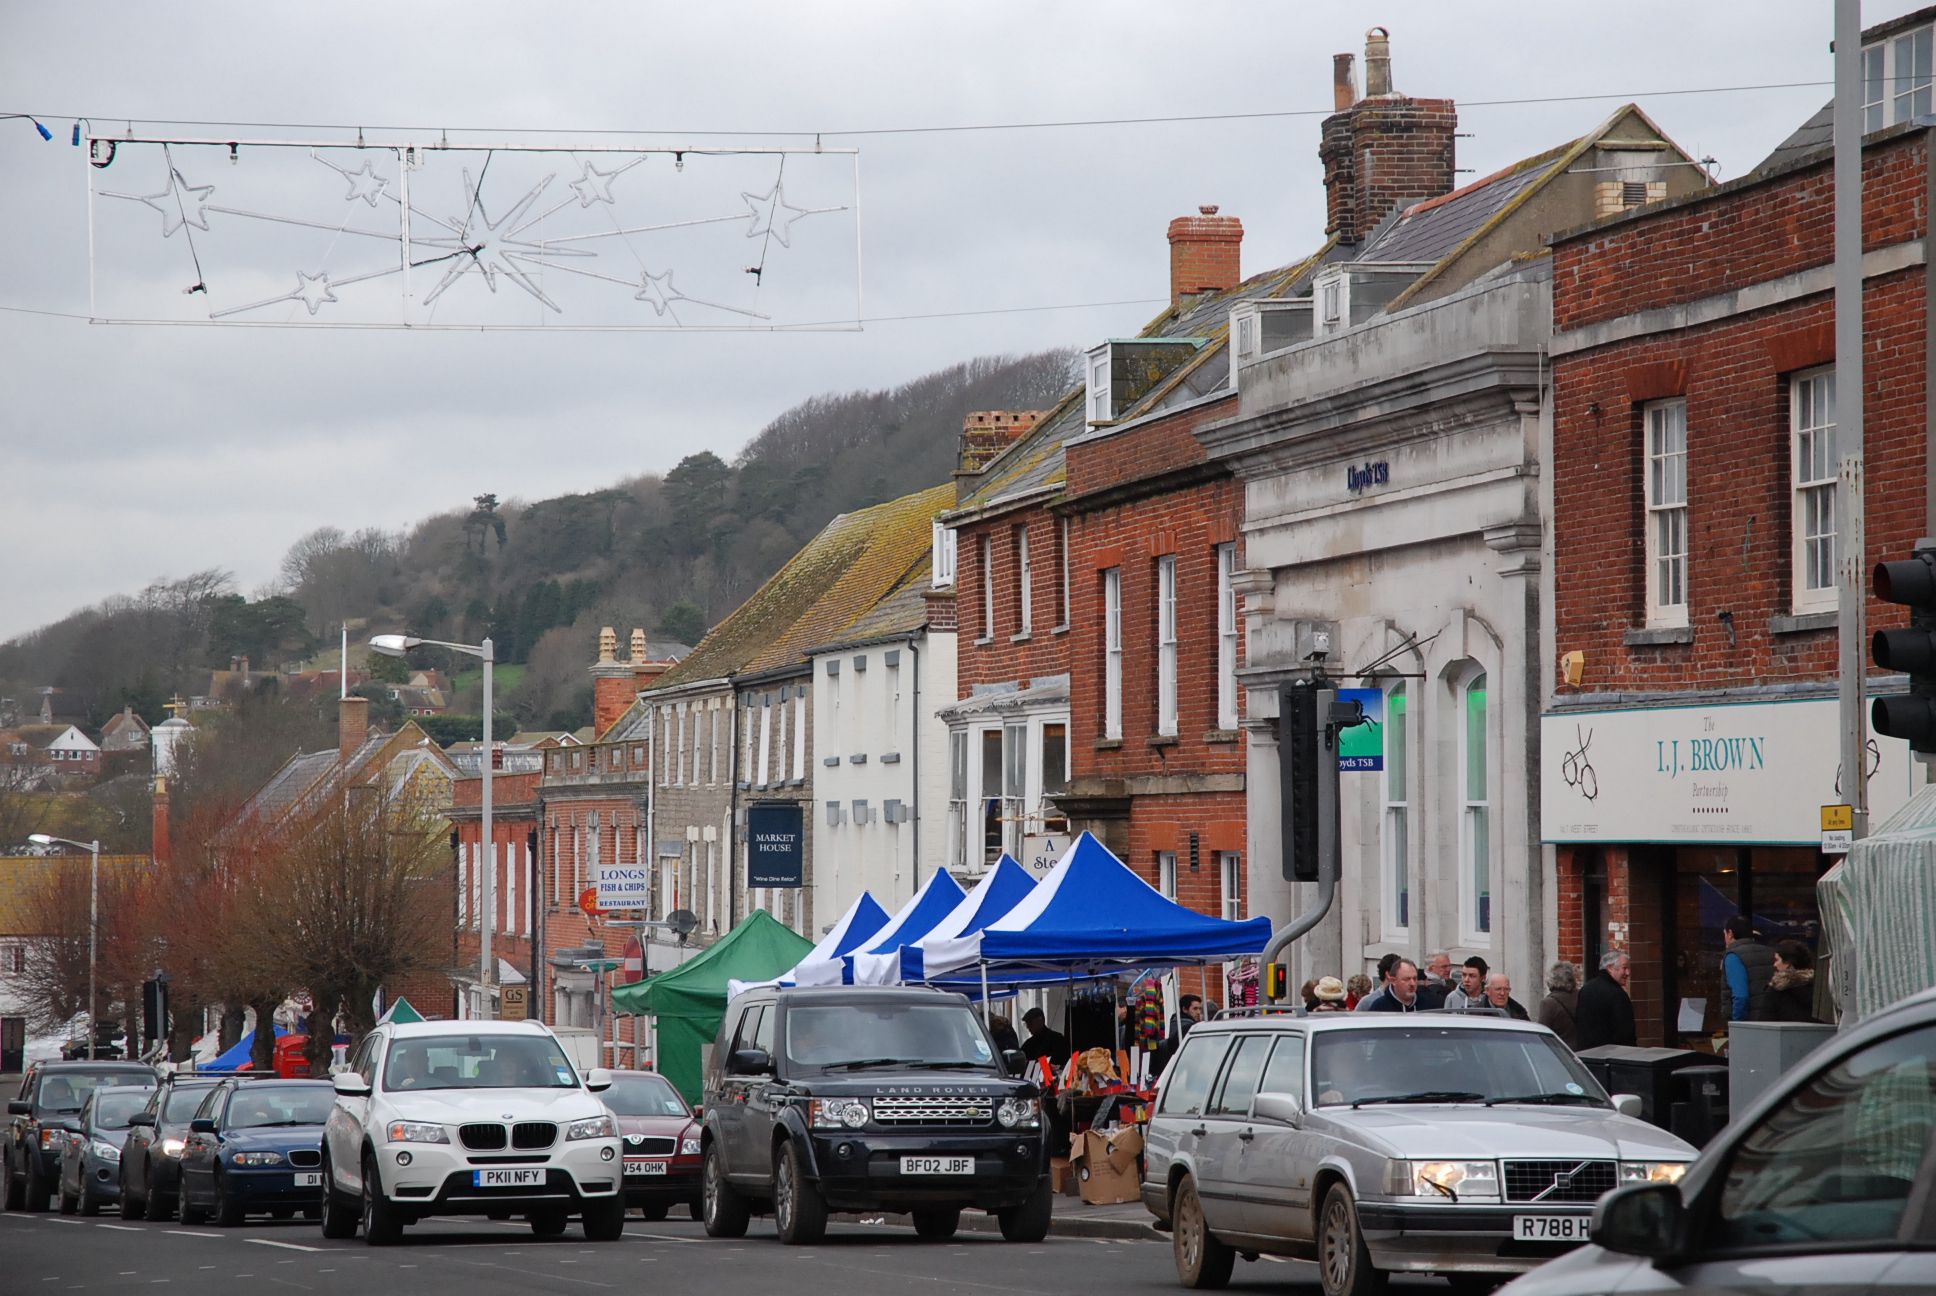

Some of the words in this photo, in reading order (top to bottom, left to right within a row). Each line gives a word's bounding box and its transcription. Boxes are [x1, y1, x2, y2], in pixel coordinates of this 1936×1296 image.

[1704, 716, 1715, 732] The
[1691, 737, 1764, 771] BROWN
[1358, 758, 1374, 767] TSB
[1692, 782, 1728, 802] Partnership
[755, 834, 796, 842] MARKET
[760, 844, 792, 852] HOUSE
[1045, 840, 1055, 852] A
[1033, 856, 1058, 870] Ste
[601, 869, 645, 880] LONGS
[601, 883, 617, 892] FISH
[618, 883, 623, 892] &
[624, 883, 645, 892] CHIPS
[622, 1163, 641, 1173] V54
[906, 1160, 941, 1172] BF02
[945, 1160, 969, 1172] JBF
[514, 1171, 539, 1183] NFY
[1522, 1218, 1573, 1236] R788
[1579, 1219, 1590, 1237] H
